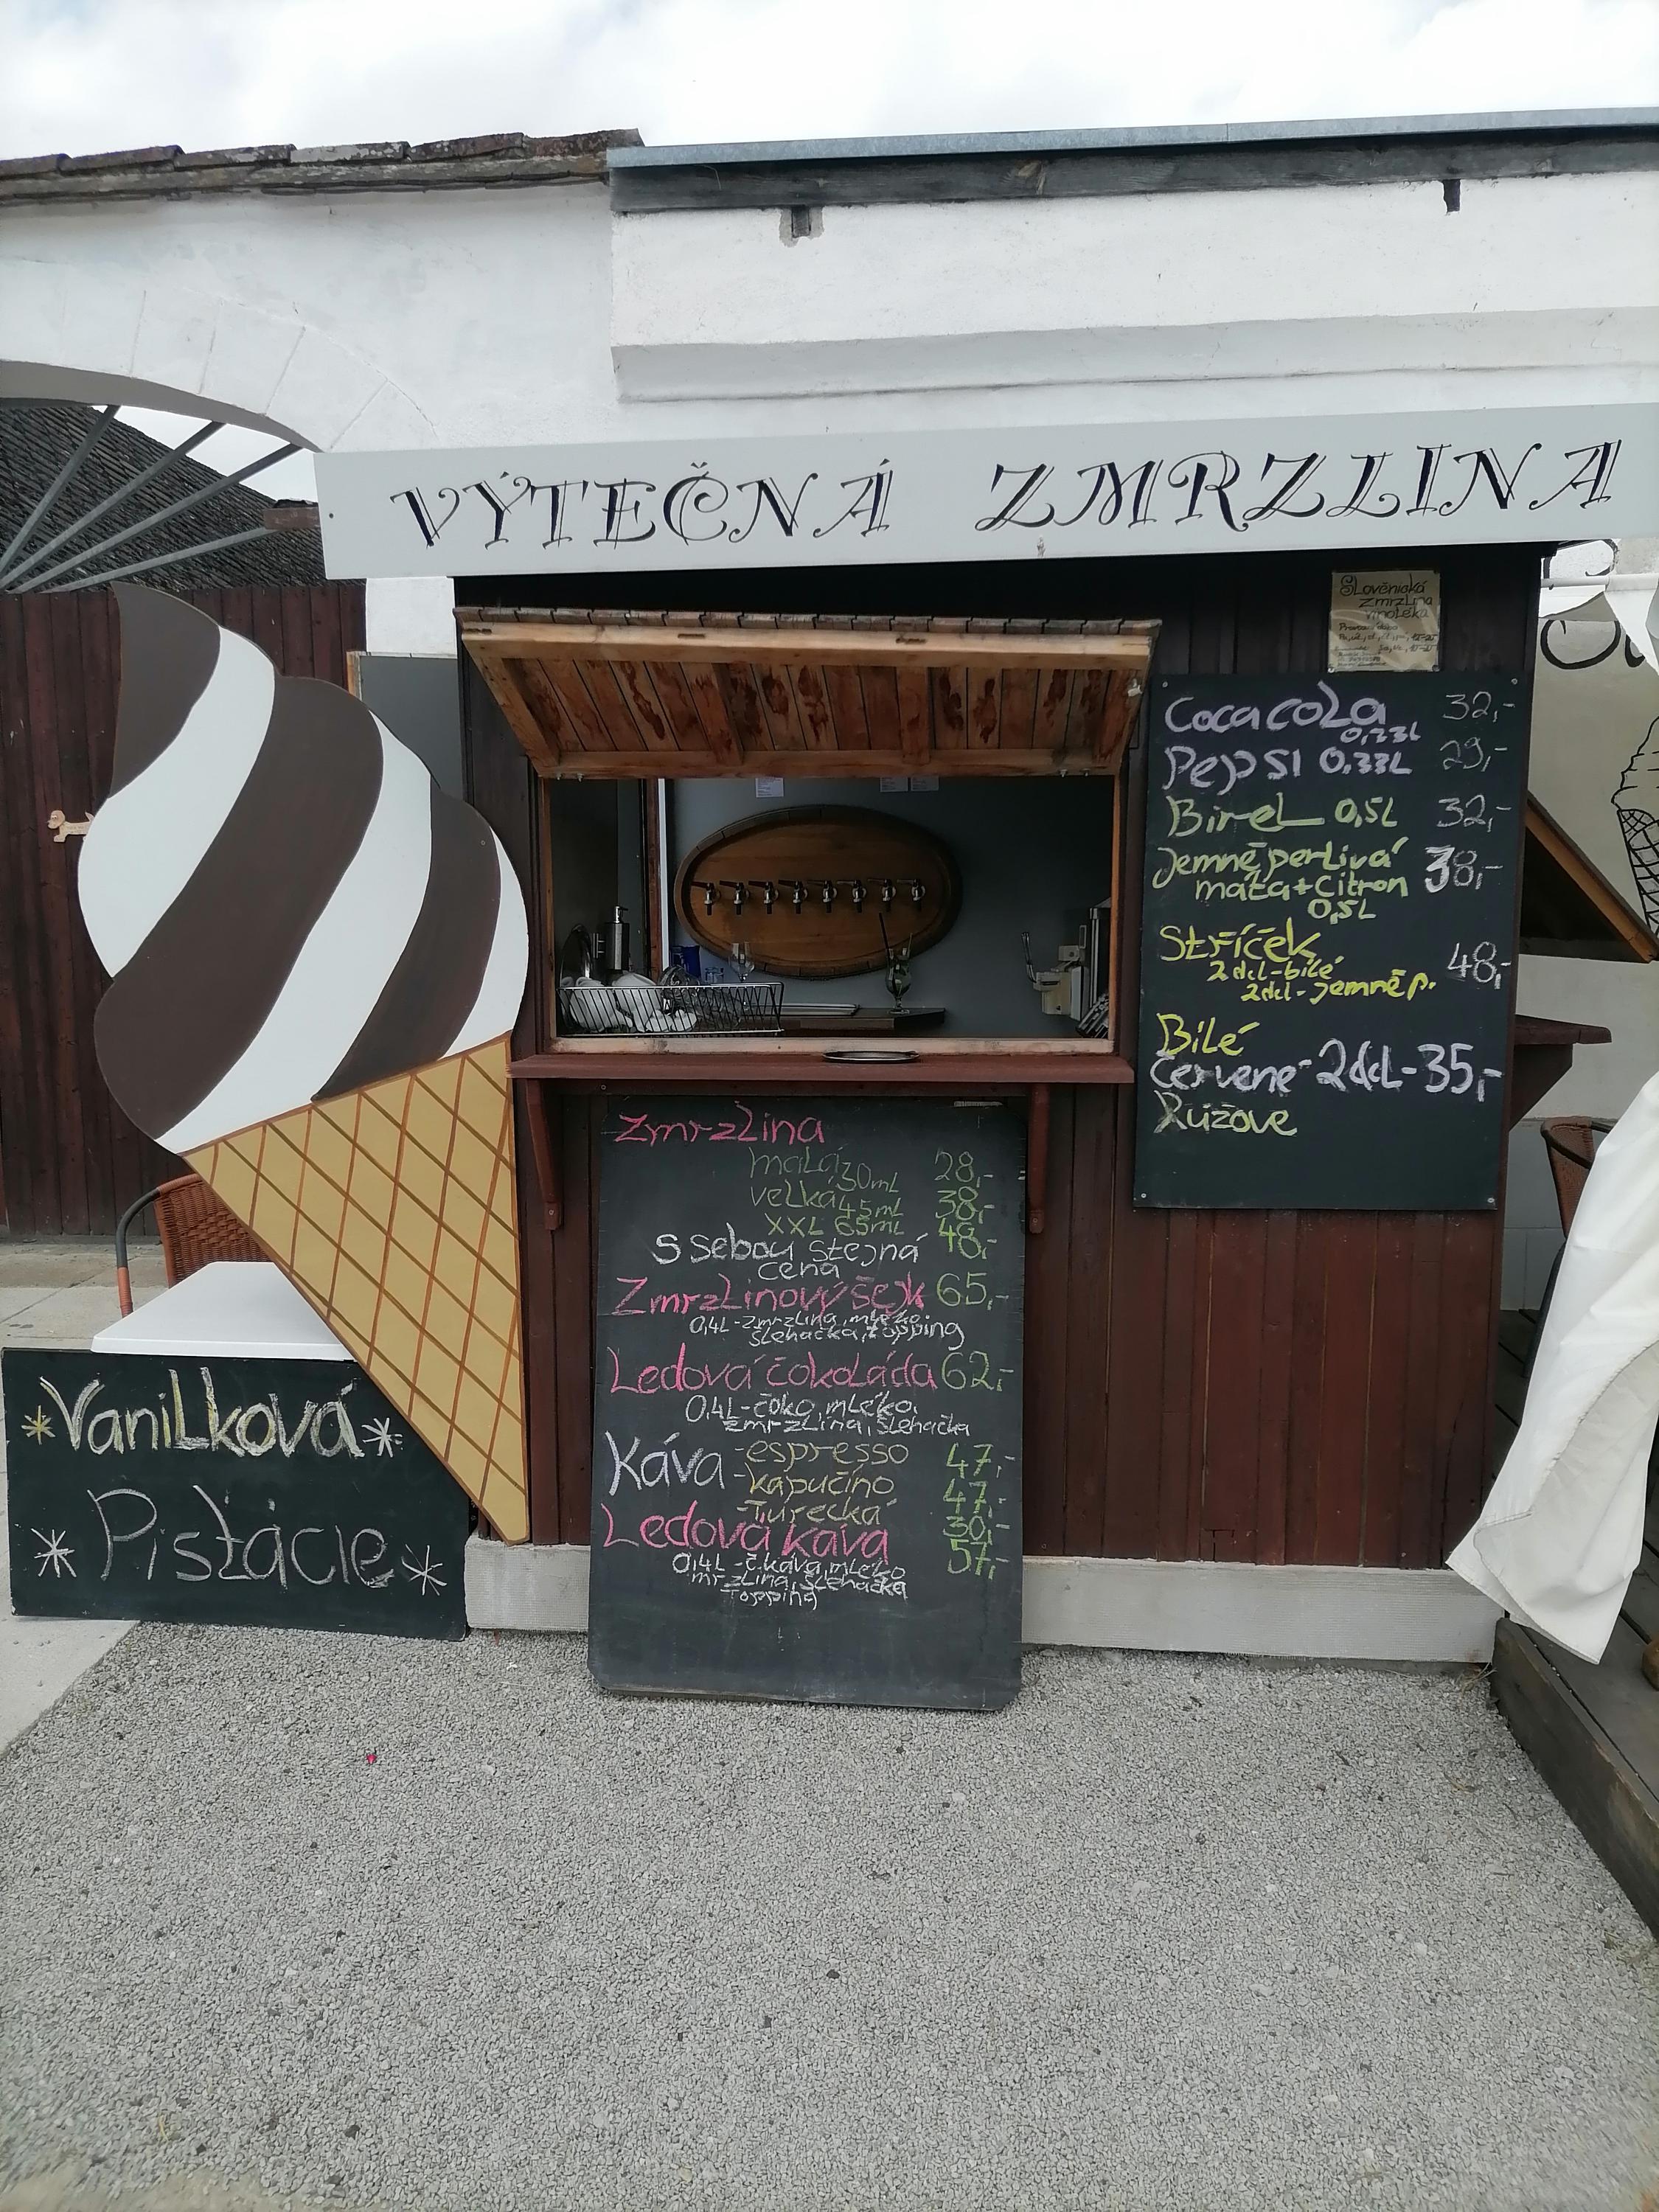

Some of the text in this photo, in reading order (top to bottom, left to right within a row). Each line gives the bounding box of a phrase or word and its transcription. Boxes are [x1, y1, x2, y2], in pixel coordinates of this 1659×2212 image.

[391, 439, 1623, 550] VÝTEČNÁ ZMRZLINA
[1318, 745, 1413, 775] 0,33L
[764, 1213, 824, 1239] XXL
[757, 1259, 841, 1281] cena
[607, 1342, 767, 1394] Ledová
[605, 1430, 725, 1497] Káva
[599, 1499, 773, 1551] Ledová
